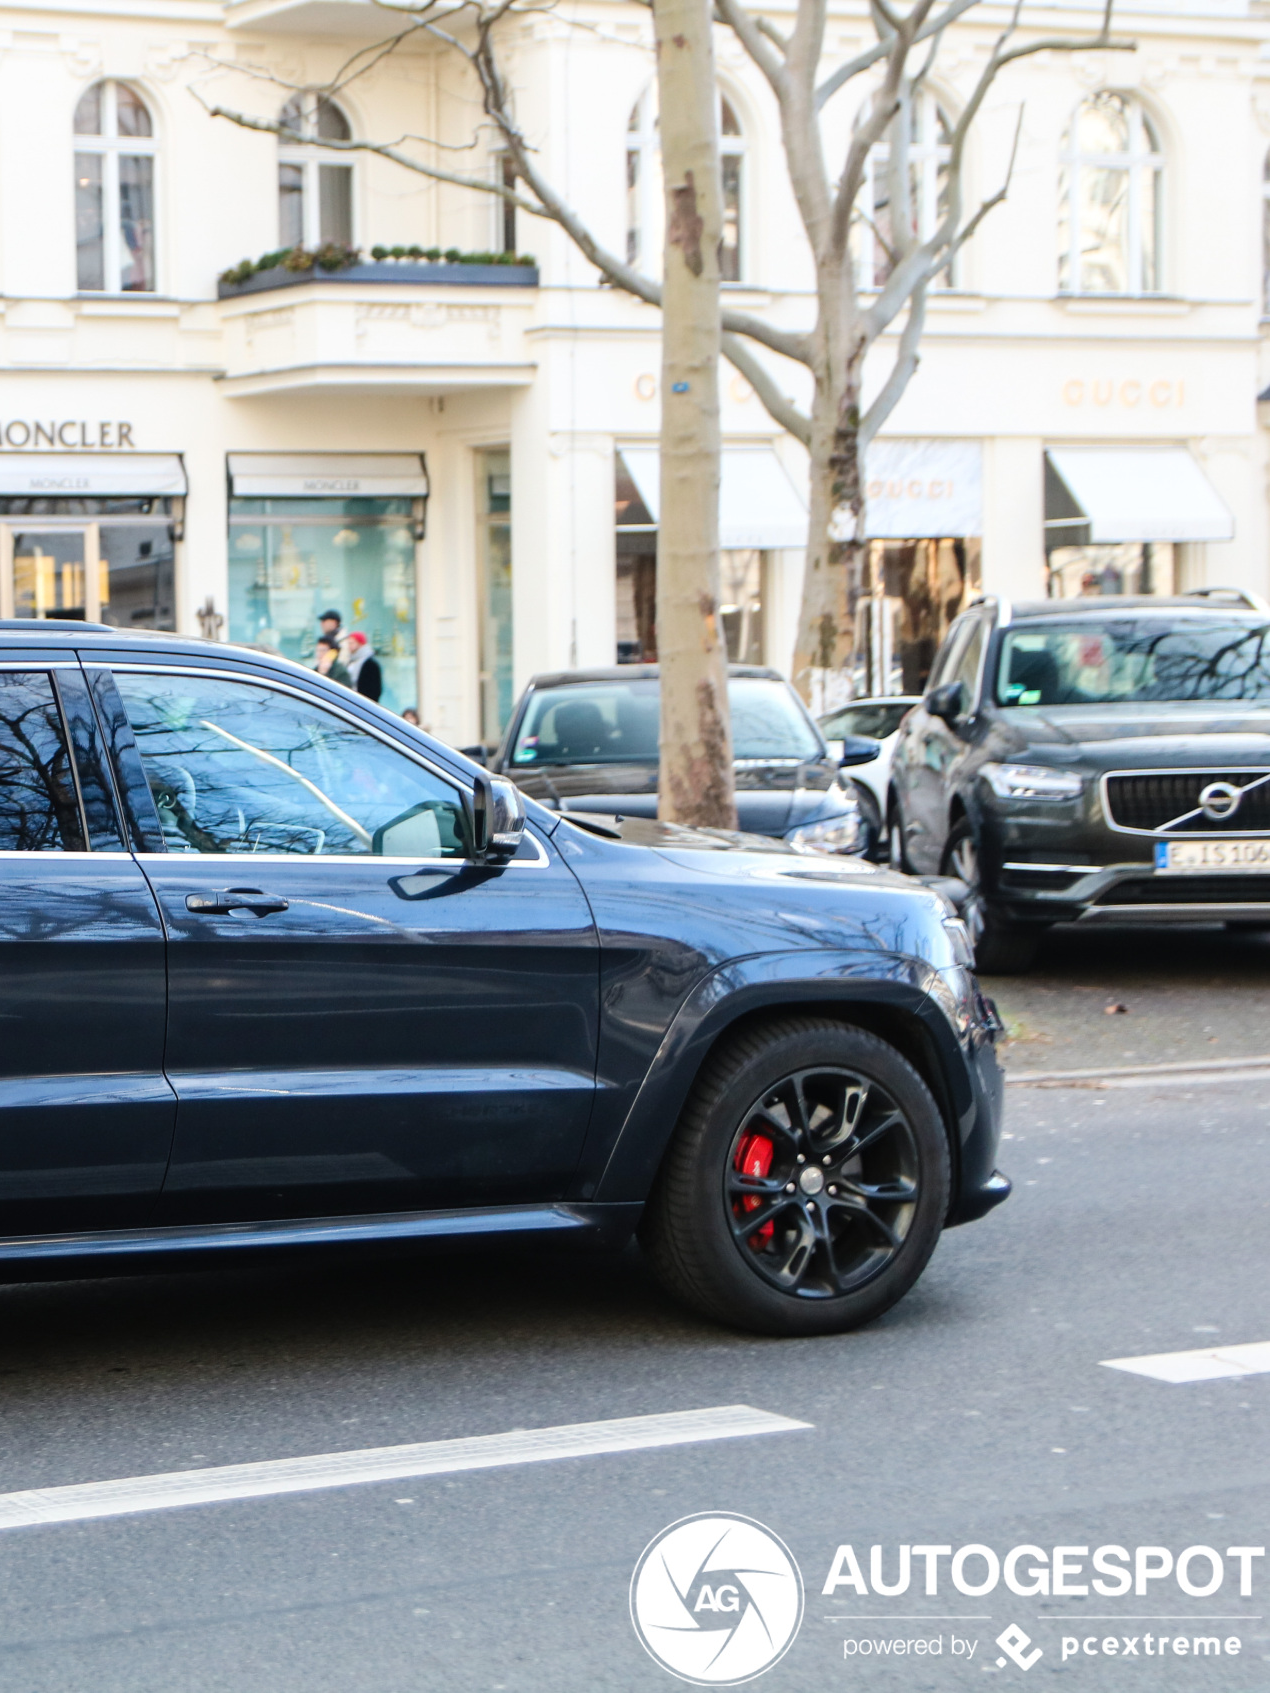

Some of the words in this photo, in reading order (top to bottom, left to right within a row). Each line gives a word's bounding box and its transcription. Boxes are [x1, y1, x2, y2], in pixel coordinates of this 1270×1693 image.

[1061, 378, 1186, 408] GUCCI
[29, 477, 91, 490] MONCLER
[303, 479, 361, 491] MONCLER
[867, 479, 955, 500] GUCCI
